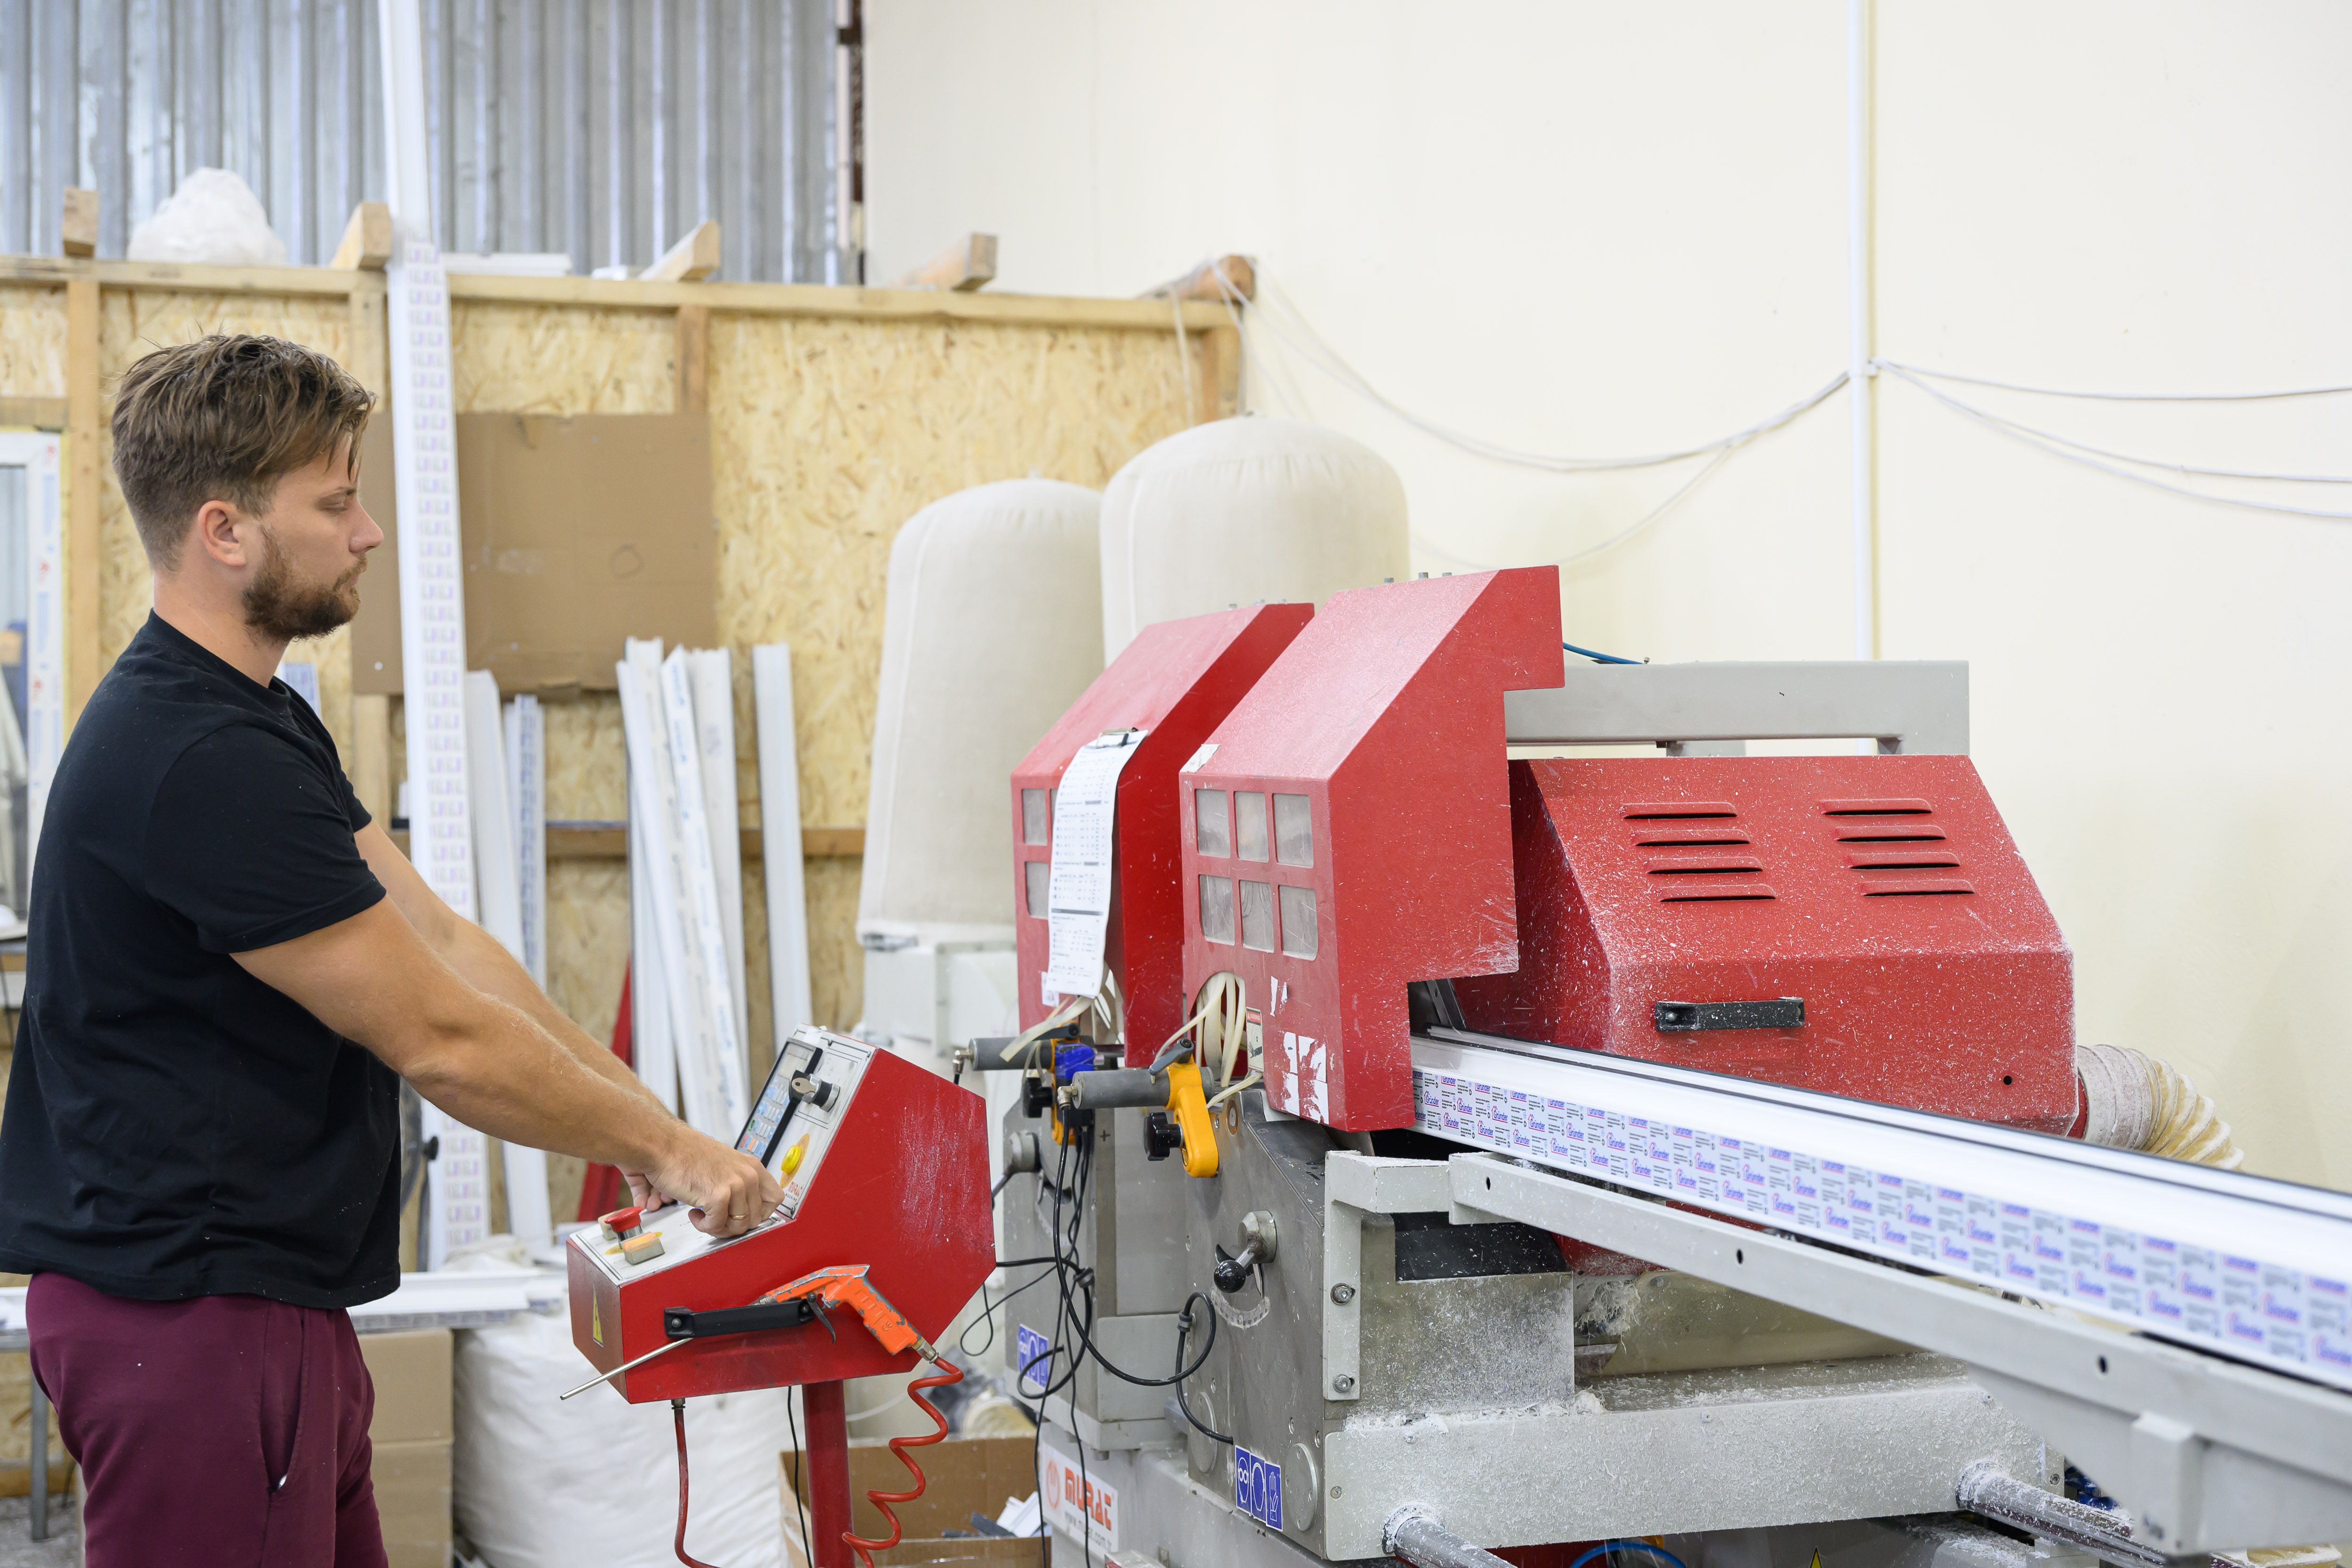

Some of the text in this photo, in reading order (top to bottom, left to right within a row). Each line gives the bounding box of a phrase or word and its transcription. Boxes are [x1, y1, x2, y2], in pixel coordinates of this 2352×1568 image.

[1426, 1095, 1439, 1105] Gründer
[1459, 1103, 1472, 1113] Gründer
[1415, 1111, 1426, 1120] ründer
[1494, 1111, 1508, 1121] Gründer
[1446, 1117, 1459, 1128] Gründer
[1530, 1119, 1545, 1130] Gründer
[1479, 1125, 1494, 1136] Gründer
[1568, 1127, 1584, 1139] Gründer
[1515, 1134, 1530, 1145] Gründer
[1609, 1138, 1626, 1149] Gründer
[1553, 1142, 1568, 1154] Gründer
[1592, 1152, 1609, 1164] Gründer
